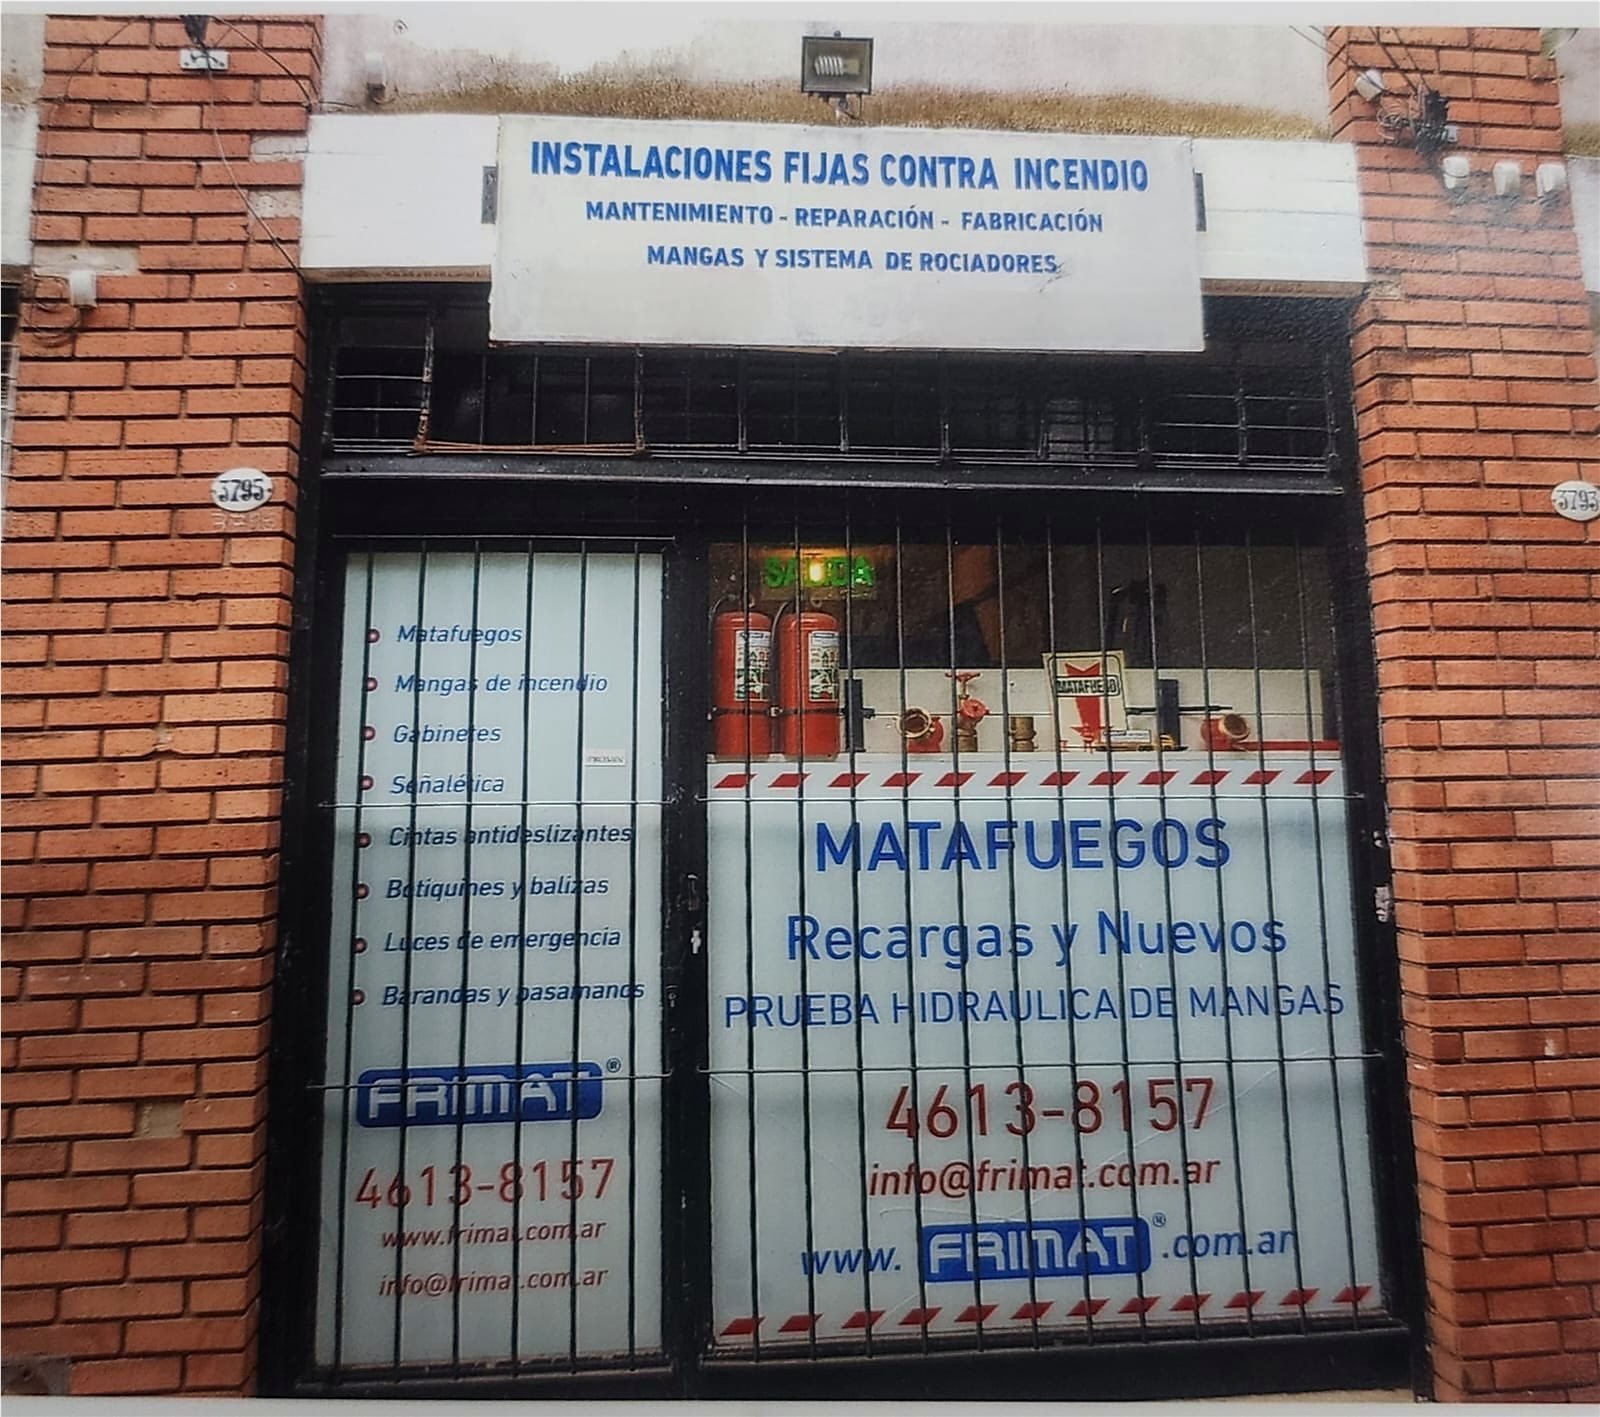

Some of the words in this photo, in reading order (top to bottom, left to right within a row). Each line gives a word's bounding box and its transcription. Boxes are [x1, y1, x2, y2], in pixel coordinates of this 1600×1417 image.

[531, 141, 772, 184] INSTALACIONES
[784, 151, 869, 187] FIJAS
[880, 153, 999, 190] CONTRA
[1015, 157, 1149, 192] INCENDIO
[586, 201, 773, 225] MANTENIMIENTO
[795, 204, 934, 230] REPARACIÓN
[961, 208, 1103, 232] FABRICACIÓN
[647, 245, 744, 268] MANGAS
[755, 248, 769, 268] Y
[775, 248, 872, 270] SISTEMA
[886, 251, 912, 272] DE
[920, 252, 1058, 274] ROCIADORES
[218, 478, 264, 502] 3795
[1556, 489, 1599, 512] 3793
[397, 625, 522, 647] Matafuegos
[394, 674, 478, 697] Mangas
[485, 673, 511, 692] de
[517, 673, 608, 692] incendio
[389, 826, 457, 847] Cintas
[464, 824, 633, 846] antideslizantes
[816, 818, 1231, 872] MATAFUEGOS
[386, 877, 504, 902] Botiquines
[511, 881, 523, 900] y
[530, 875, 609, 896] balizas
[384, 931, 450, 952] Luces
[457, 930, 483, 950] de
[490, 926, 621, 952] emergencia
[788, 915, 1034, 970] Recargas
[1052, 923, 1078, 968] y
[1097, 910, 1287, 954] Nuevos
[382, 985, 490, 1006] Barandas
[498, 987, 511, 1007] y
[515, 983, 644, 1007] pasamanos
[725, 992, 880, 1029] PRUEBA
[893, 988, 1118, 1024] HIDRAULICA
[1130, 986, 1175, 1020] DE
[1189, 983, 1344, 1018] MANGAS
[886, 1078, 1214, 1139] 4613-8157
[356, 1157, 615, 1209] 4613-8157
[801, 1247, 901, 1275] www.
[930, 1225, 1135, 1274] FRIMAT
[1162, 1229, 1297, 1259] .com.ar
